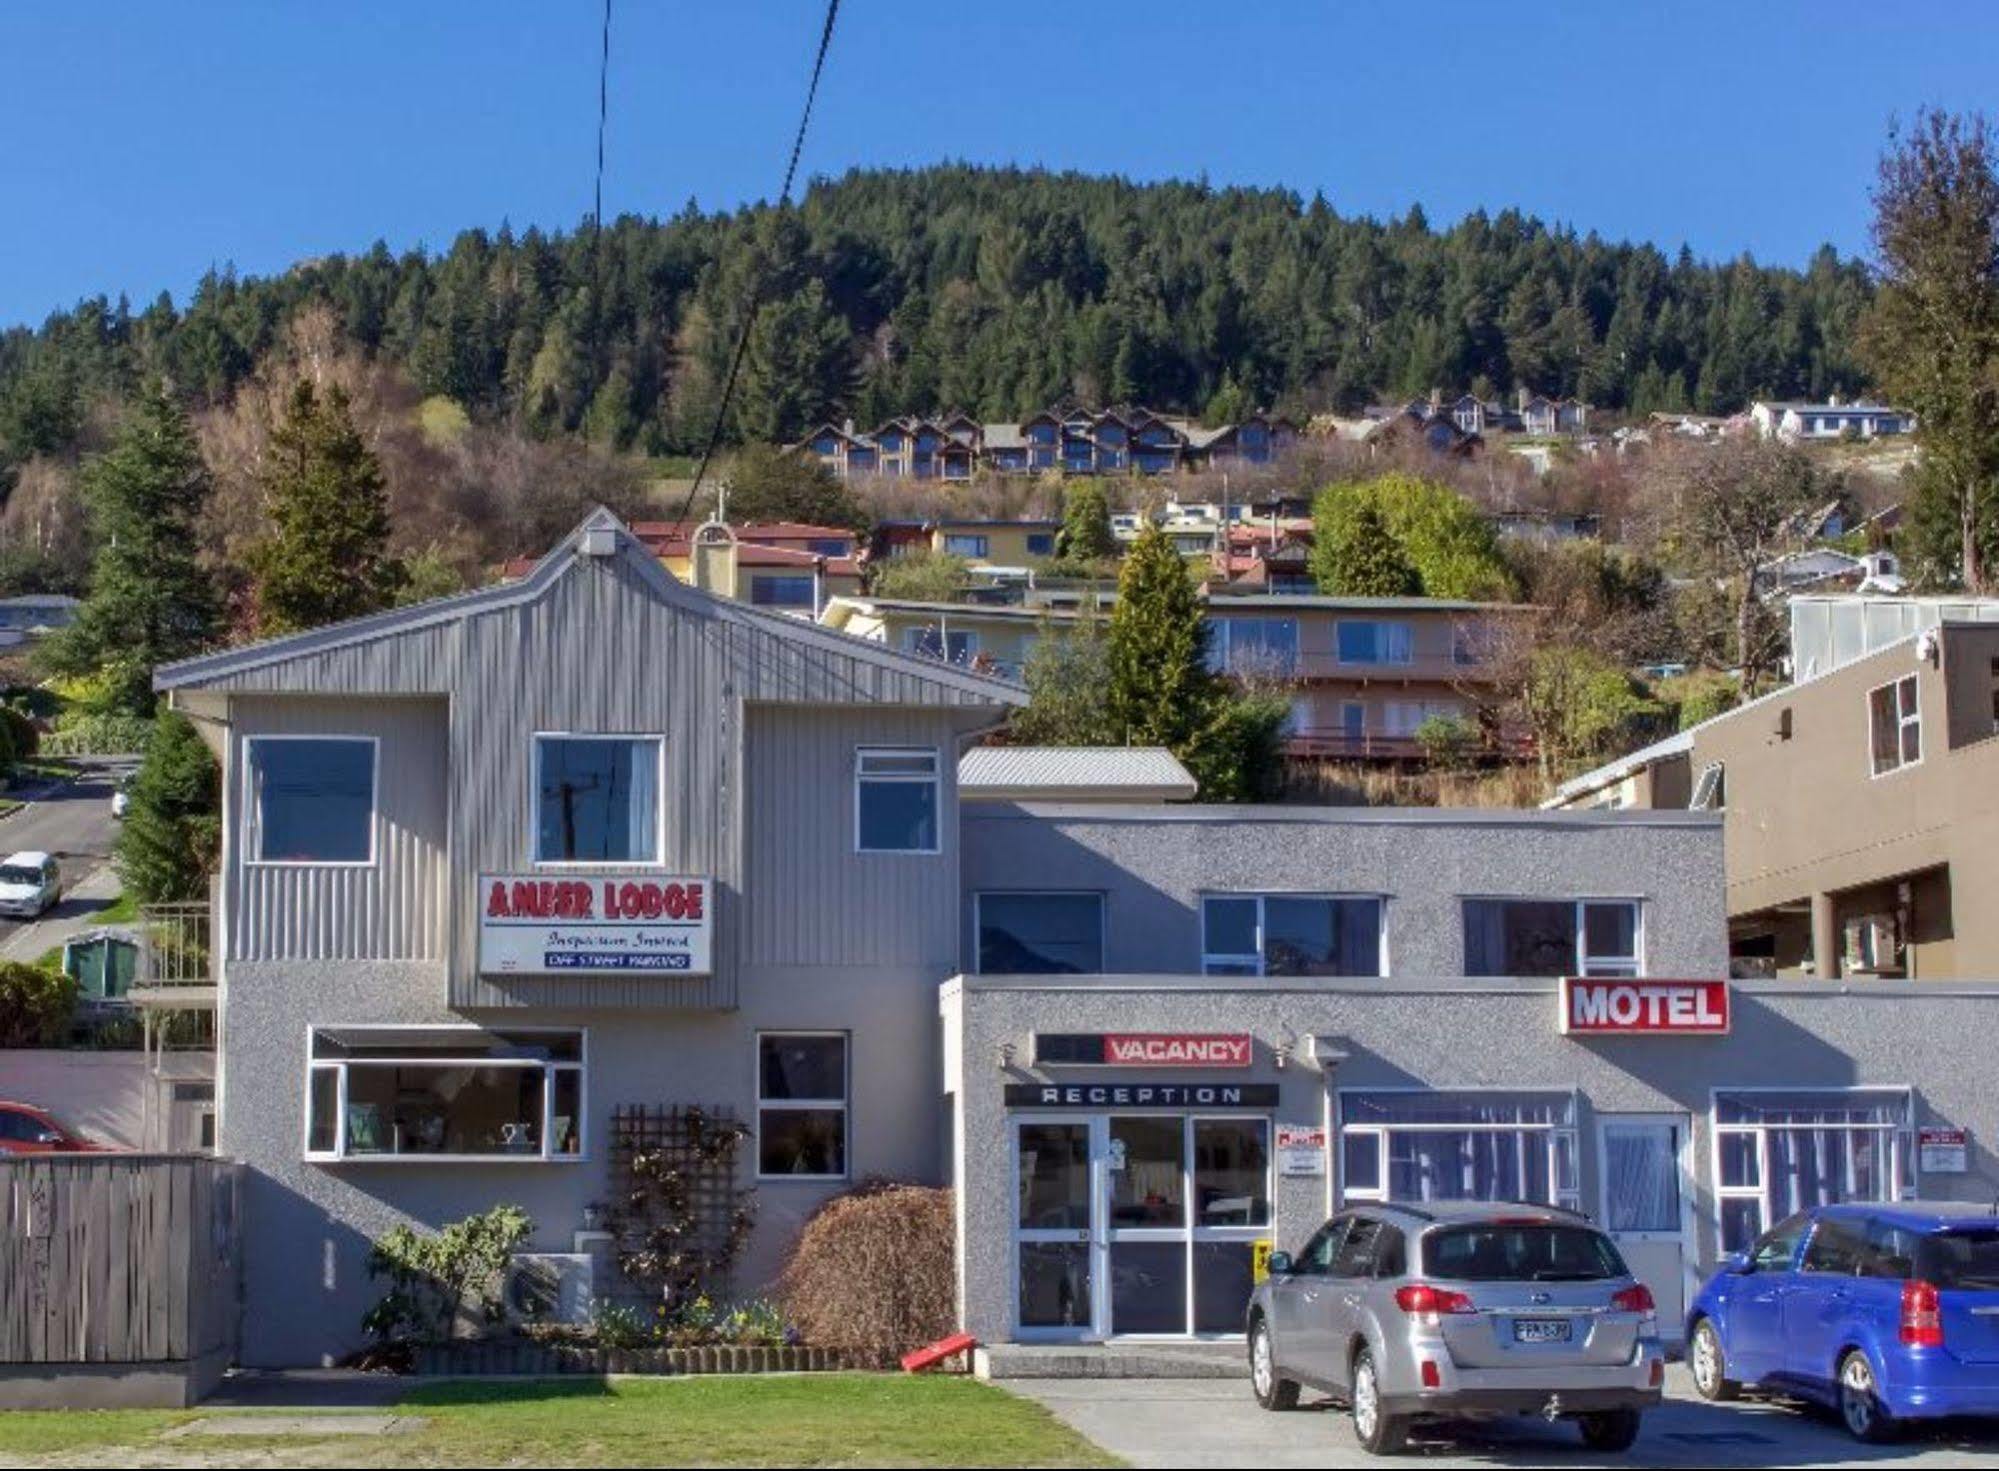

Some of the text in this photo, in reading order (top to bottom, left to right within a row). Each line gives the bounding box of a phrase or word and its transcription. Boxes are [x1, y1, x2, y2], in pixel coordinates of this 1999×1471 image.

[487, 880, 703, 920] AMBER LODGE
[549, 954, 686, 968] OFF STREET PARKING
[1573, 985, 1723, 1025] MOTEL
[1110, 1040, 1249, 1061] VACANCY
[1042, 1088, 1241, 1103] RECEPTION
